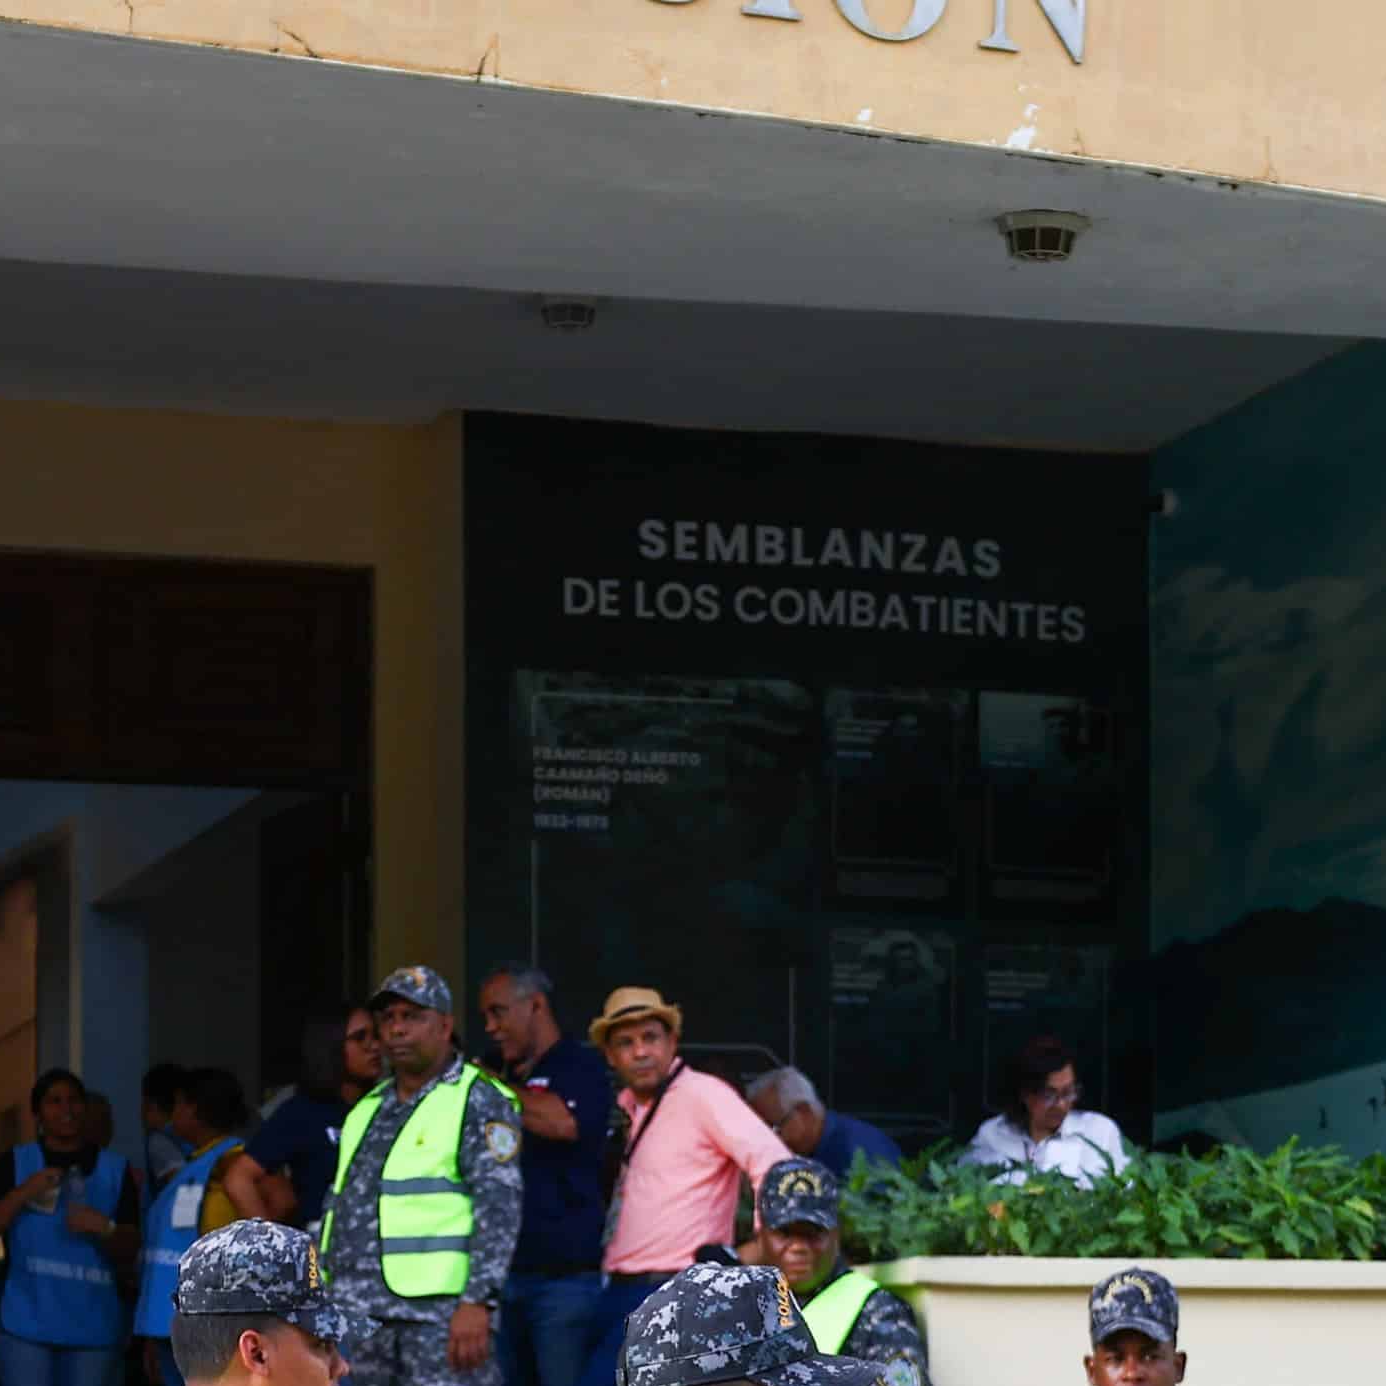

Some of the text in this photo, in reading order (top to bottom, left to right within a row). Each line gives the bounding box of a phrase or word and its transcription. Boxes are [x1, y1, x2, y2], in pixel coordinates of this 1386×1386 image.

[638, 518, 1002, 578] SEMBLANZAS
[562, 575, 1086, 643] DE LOS COMBATIENTES
